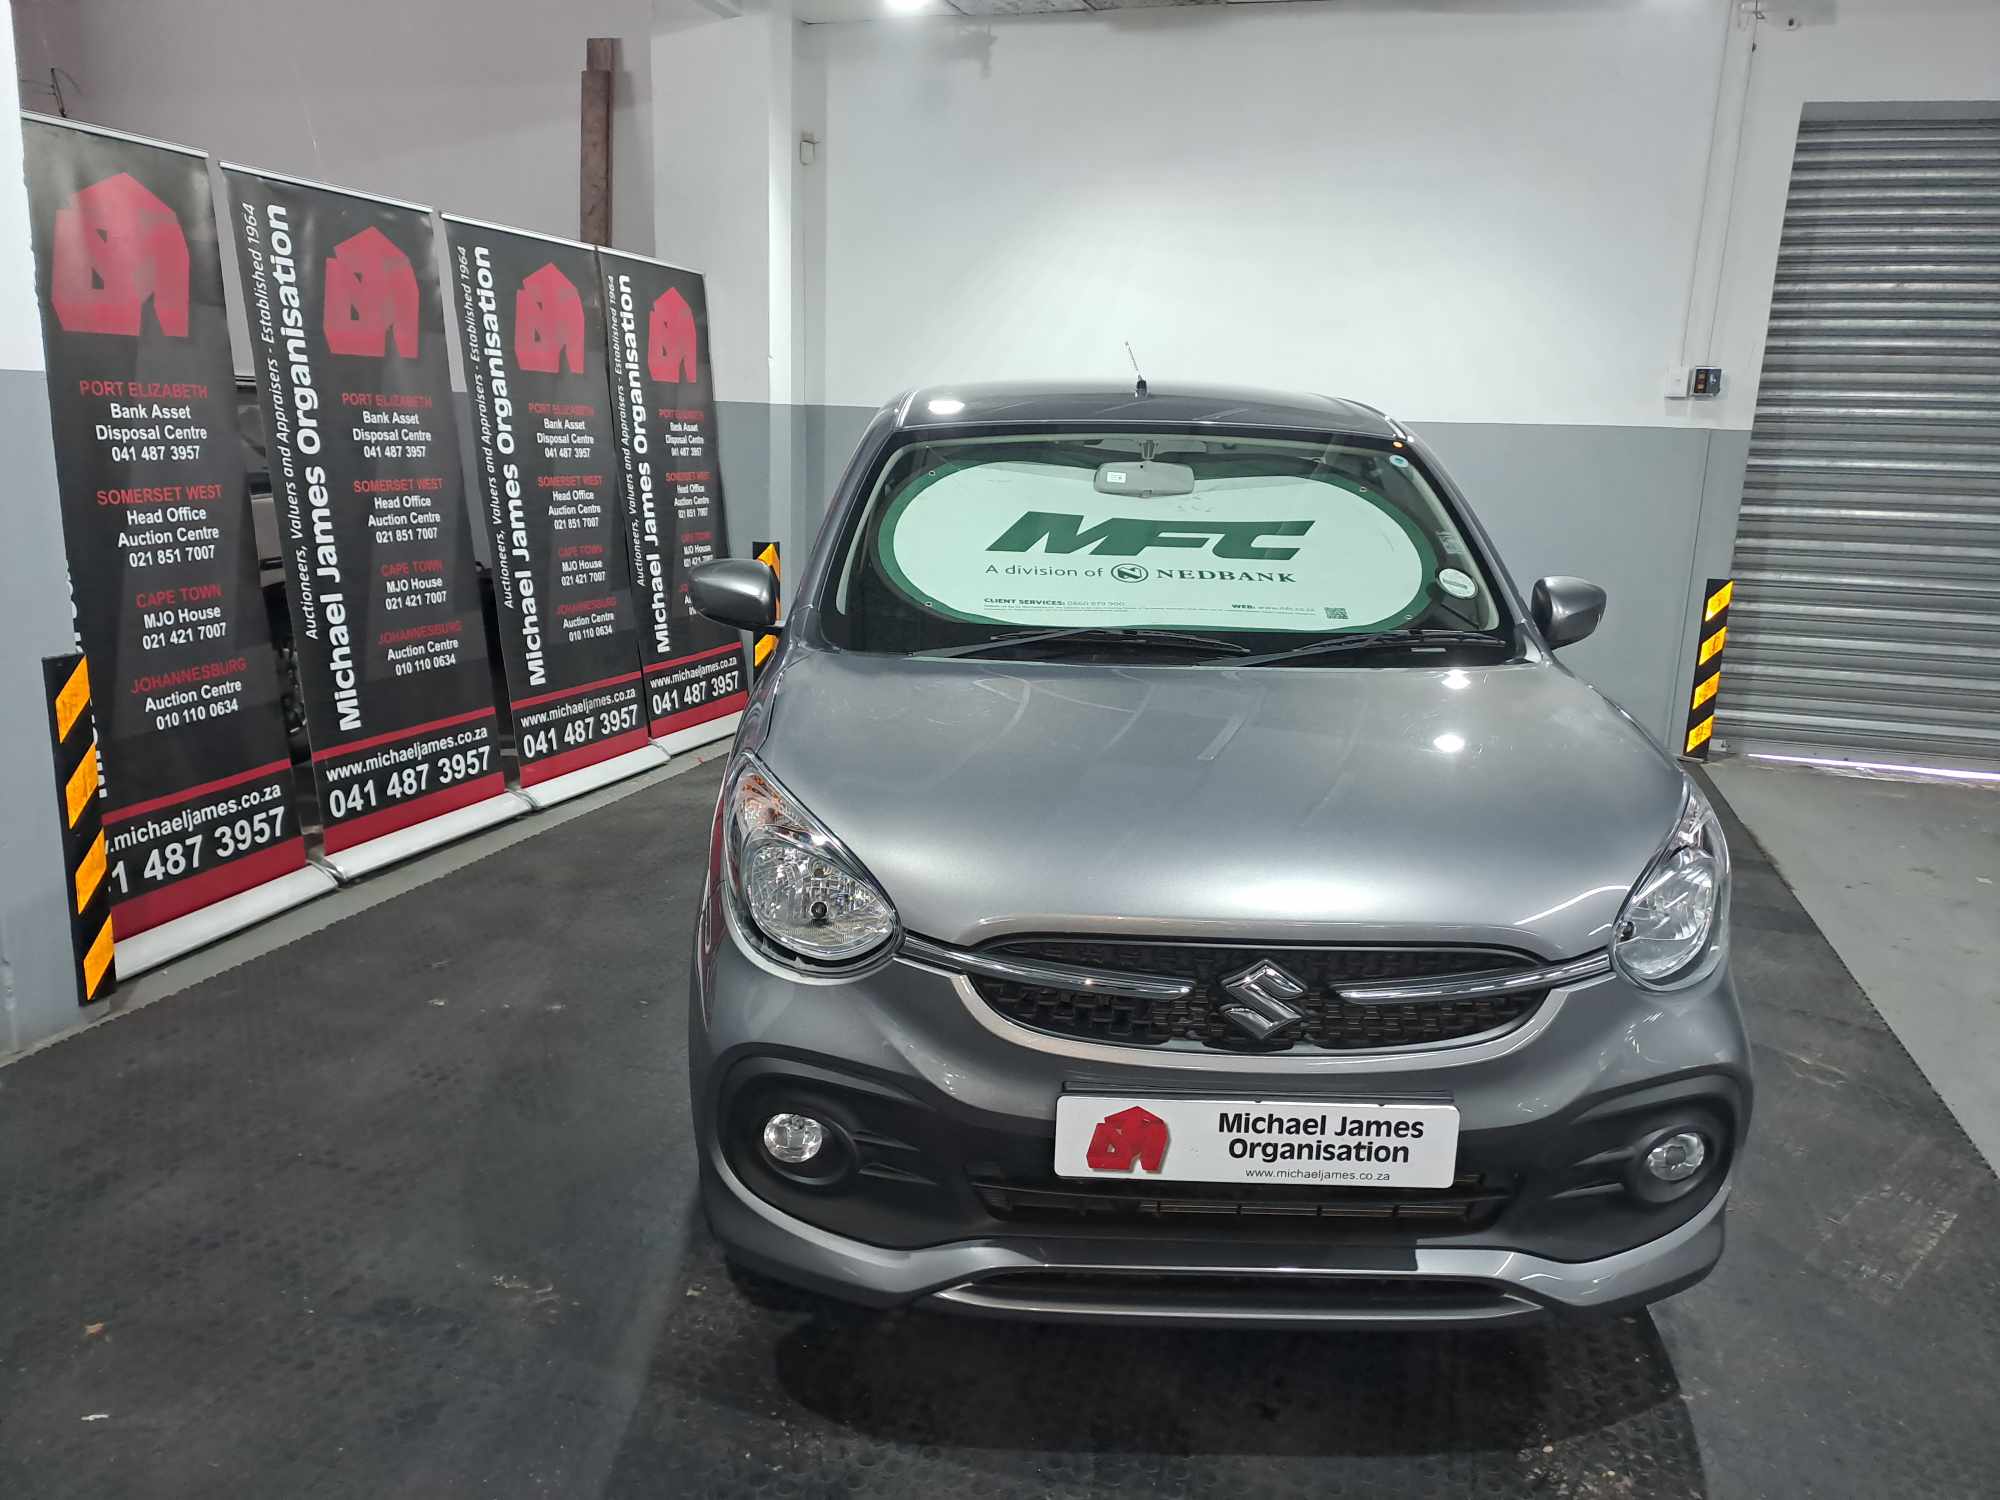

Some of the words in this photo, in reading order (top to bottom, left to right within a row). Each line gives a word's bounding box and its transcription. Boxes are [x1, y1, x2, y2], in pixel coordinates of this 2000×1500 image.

[242, 202, 260, 244] 1964
[457, 246, 470, 282] 1964
[250, 246, 275, 344] Established
[607, 275, 616, 304] 1964
[267, 204, 321, 455] Organisation
[461, 283, 480, 362] Established
[475, 247, 515, 455] Organisation
[608, 306, 623, 374] Established
[618, 275, 648, 455] Organisation
[79, 380, 124, 397] PORT
[128, 383, 208, 398] ELIZABETH
[265, 358, 290, 444] Appraisers
[342, 393, 373, 406] PORT
[110, 403, 148, 419] Bank
[152, 404, 191, 419] Asset
[363, 411, 390, 424] Bank
[392, 412, 420, 424] Asset
[475, 373, 492, 444] Appraisers
[617, 385, 630, 446] Appraisers
[95, 425, 159, 443] Disposal
[165, 425, 207, 440] Centre
[353, 428, 398, 443] Disposal
[401, 429, 432, 441] Centre
[544, 418, 562, 429] Bank
[564, 420, 585, 430] Asset
[363, 446, 382, 458] 041
[384, 446, 401, 457] 487
[406, 446, 426, 457] 3957
[536, 433, 569, 445] Disposal
[571, 433, 594, 444] Centre
[112, 447, 136, 462] 041
[141, 446, 165, 461] 487
[172, 445, 200, 460] 3957
[276, 446, 295, 478] and
[483, 447, 495, 473] and
[622, 447, 632, 470] and
[96, 487, 182, 505] SOMERSET
[186, 484, 222, 500] WEST
[353, 479, 415, 493] SOMERSET
[552, 491, 571, 501] Head
[573, 490, 594, 500] Office
[626, 473, 637, 514] Valuers
[285, 481, 304, 539] Valuers
[374, 497, 400, 509] Head
[403, 496, 431, 507] Office
[490, 476, 501, 526] Valuers
[503, 463, 529, 561] James
[548, 505, 576, 516] Auction
[578, 504, 601, 514] Centre
[638, 462, 659, 547] James
[126, 509, 162, 525] Head
[167, 507, 207, 522] Office
[305, 466, 341, 583] James
[368, 514, 407, 527] Auction
[410, 512, 441, 523] Centre
[554, 519, 566, 530] 021
[118, 530, 173, 548] Auction
[177, 526, 220, 542] Centre
[376, 531, 394, 544] 021
[396, 529, 414, 542] 851
[416, 527, 438, 539] 7007
[984, 511, 1315, 560] MFC
[129, 551, 153, 567] 021
[157, 548, 181, 564] 851
[186, 545, 215, 561] 7007
[579, 560, 602, 570] House
[631, 519, 645, 587] Auctioneers,
[380, 564, 409, 576] CAPE
[498, 530, 514, 609] Auctioneers,
[575, 573, 587, 584] 421
[985, 564, 999, 574] A
[1005, 565, 1078, 577] division
[1084, 567, 1103, 577] of
[1157, 569, 1297, 583] NEDBANK
[136, 590, 175, 608] CAPE
[179, 584, 222, 601] TOWN
[296, 546, 318, 639] Auctioneers,
[386, 580, 409, 593] MJO
[411, 578, 443, 589] House
[385, 597, 402, 610] 021
[405, 594, 422, 607] 421
[424, 591, 447, 604] 7007
[646, 553, 671, 654] Michael
[984, 597, 1016, 605] CLIENT
[143, 611, 174, 629] MJO
[178, 606, 221, 623] House
[514, 570, 546, 686] Michael
[563, 616, 590, 629] Auction
[142, 634, 165, 650] 021
[170, 628, 193, 644] 421
[198, 622, 227, 640] 7007
[387, 645, 425, 661] Auction
[427, 639, 459, 652] Centre
[131, 657, 247, 694] JOHANNESBURG
[320, 593, 362, 732] Michael
[395, 663, 413, 676] 010
[414, 658, 431, 672] 110
[434, 654, 456, 668] 0634
[650, 656, 737, 689] www.michaeljames.co.za
[145, 690, 197, 712] Auction
[201, 680, 242, 699] Centre
[652, 689, 680, 715] 041
[683, 681, 706, 704] 487
[711, 671, 739, 697] 3957
[156, 712, 179, 730] 010
[183, 705, 206, 724] 110
[209, 698, 239, 717] 0634
[520, 687, 636, 728] www.michaeljames.co.za
[523, 727, 558, 758] 041
[564, 716, 595, 746] 487
[600, 704, 638, 735] 3957
[326, 728, 488, 782] www.michaeljames.co.za
[329, 779, 377, 818] 041
[387, 764, 429, 799] 487
[437, 745, 490, 784] 3957
[105, 784, 281, 854] .michaeljames.co.za
[144, 834, 203, 881] 487
[214, 806, 285, 857] 3957
[1218, 1113, 1326, 1136] Michael
[1334, 1116, 1424, 1138] James
[1228, 1138, 1409, 1163] Organisation
